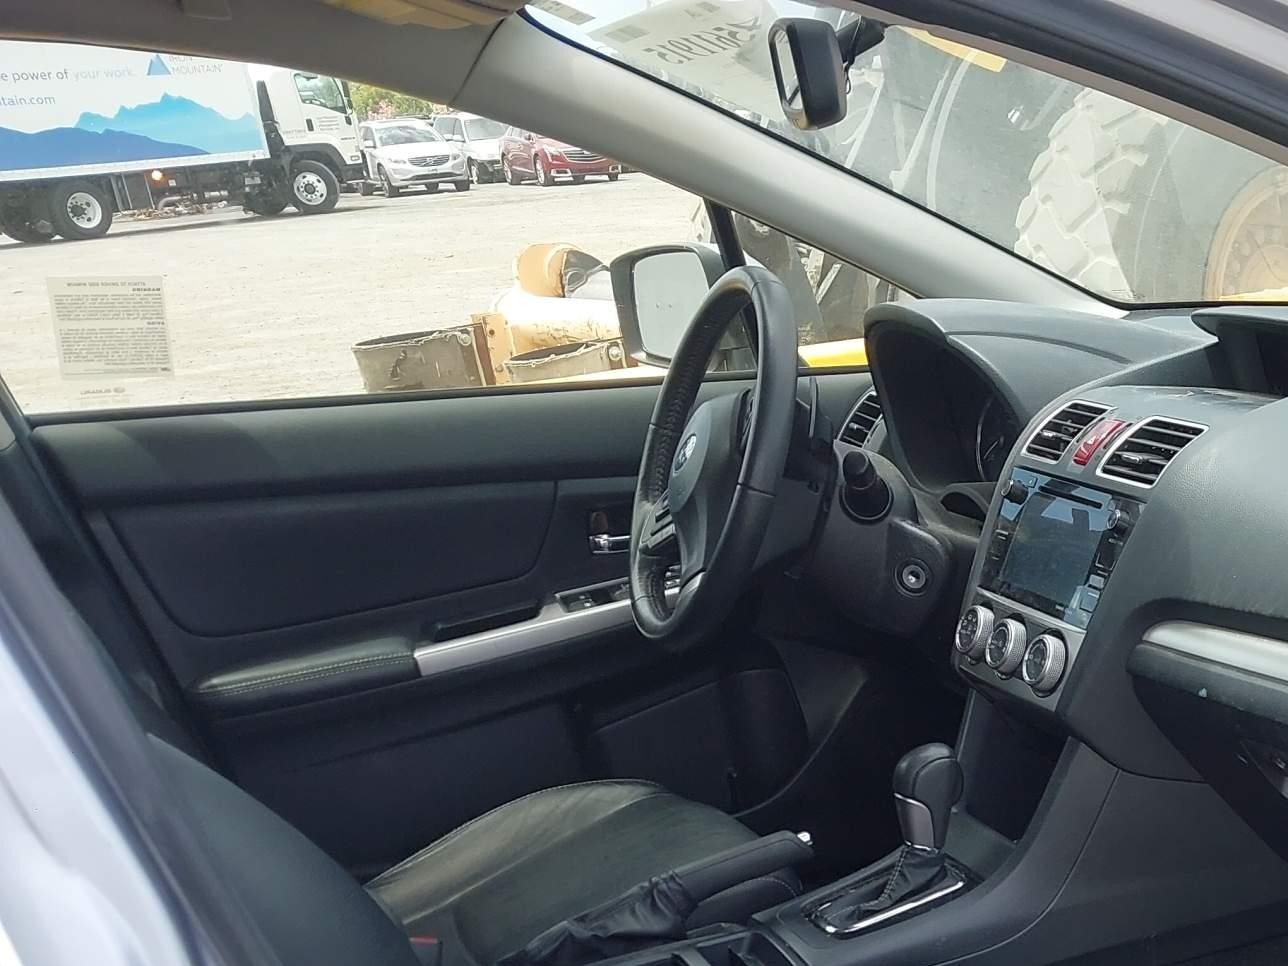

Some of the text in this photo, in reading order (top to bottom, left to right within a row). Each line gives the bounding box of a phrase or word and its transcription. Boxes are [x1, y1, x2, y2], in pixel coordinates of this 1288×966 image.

[12, 71, 52, 84] power
[55, 68, 69, 80] of
[73, 69, 100, 82] your
